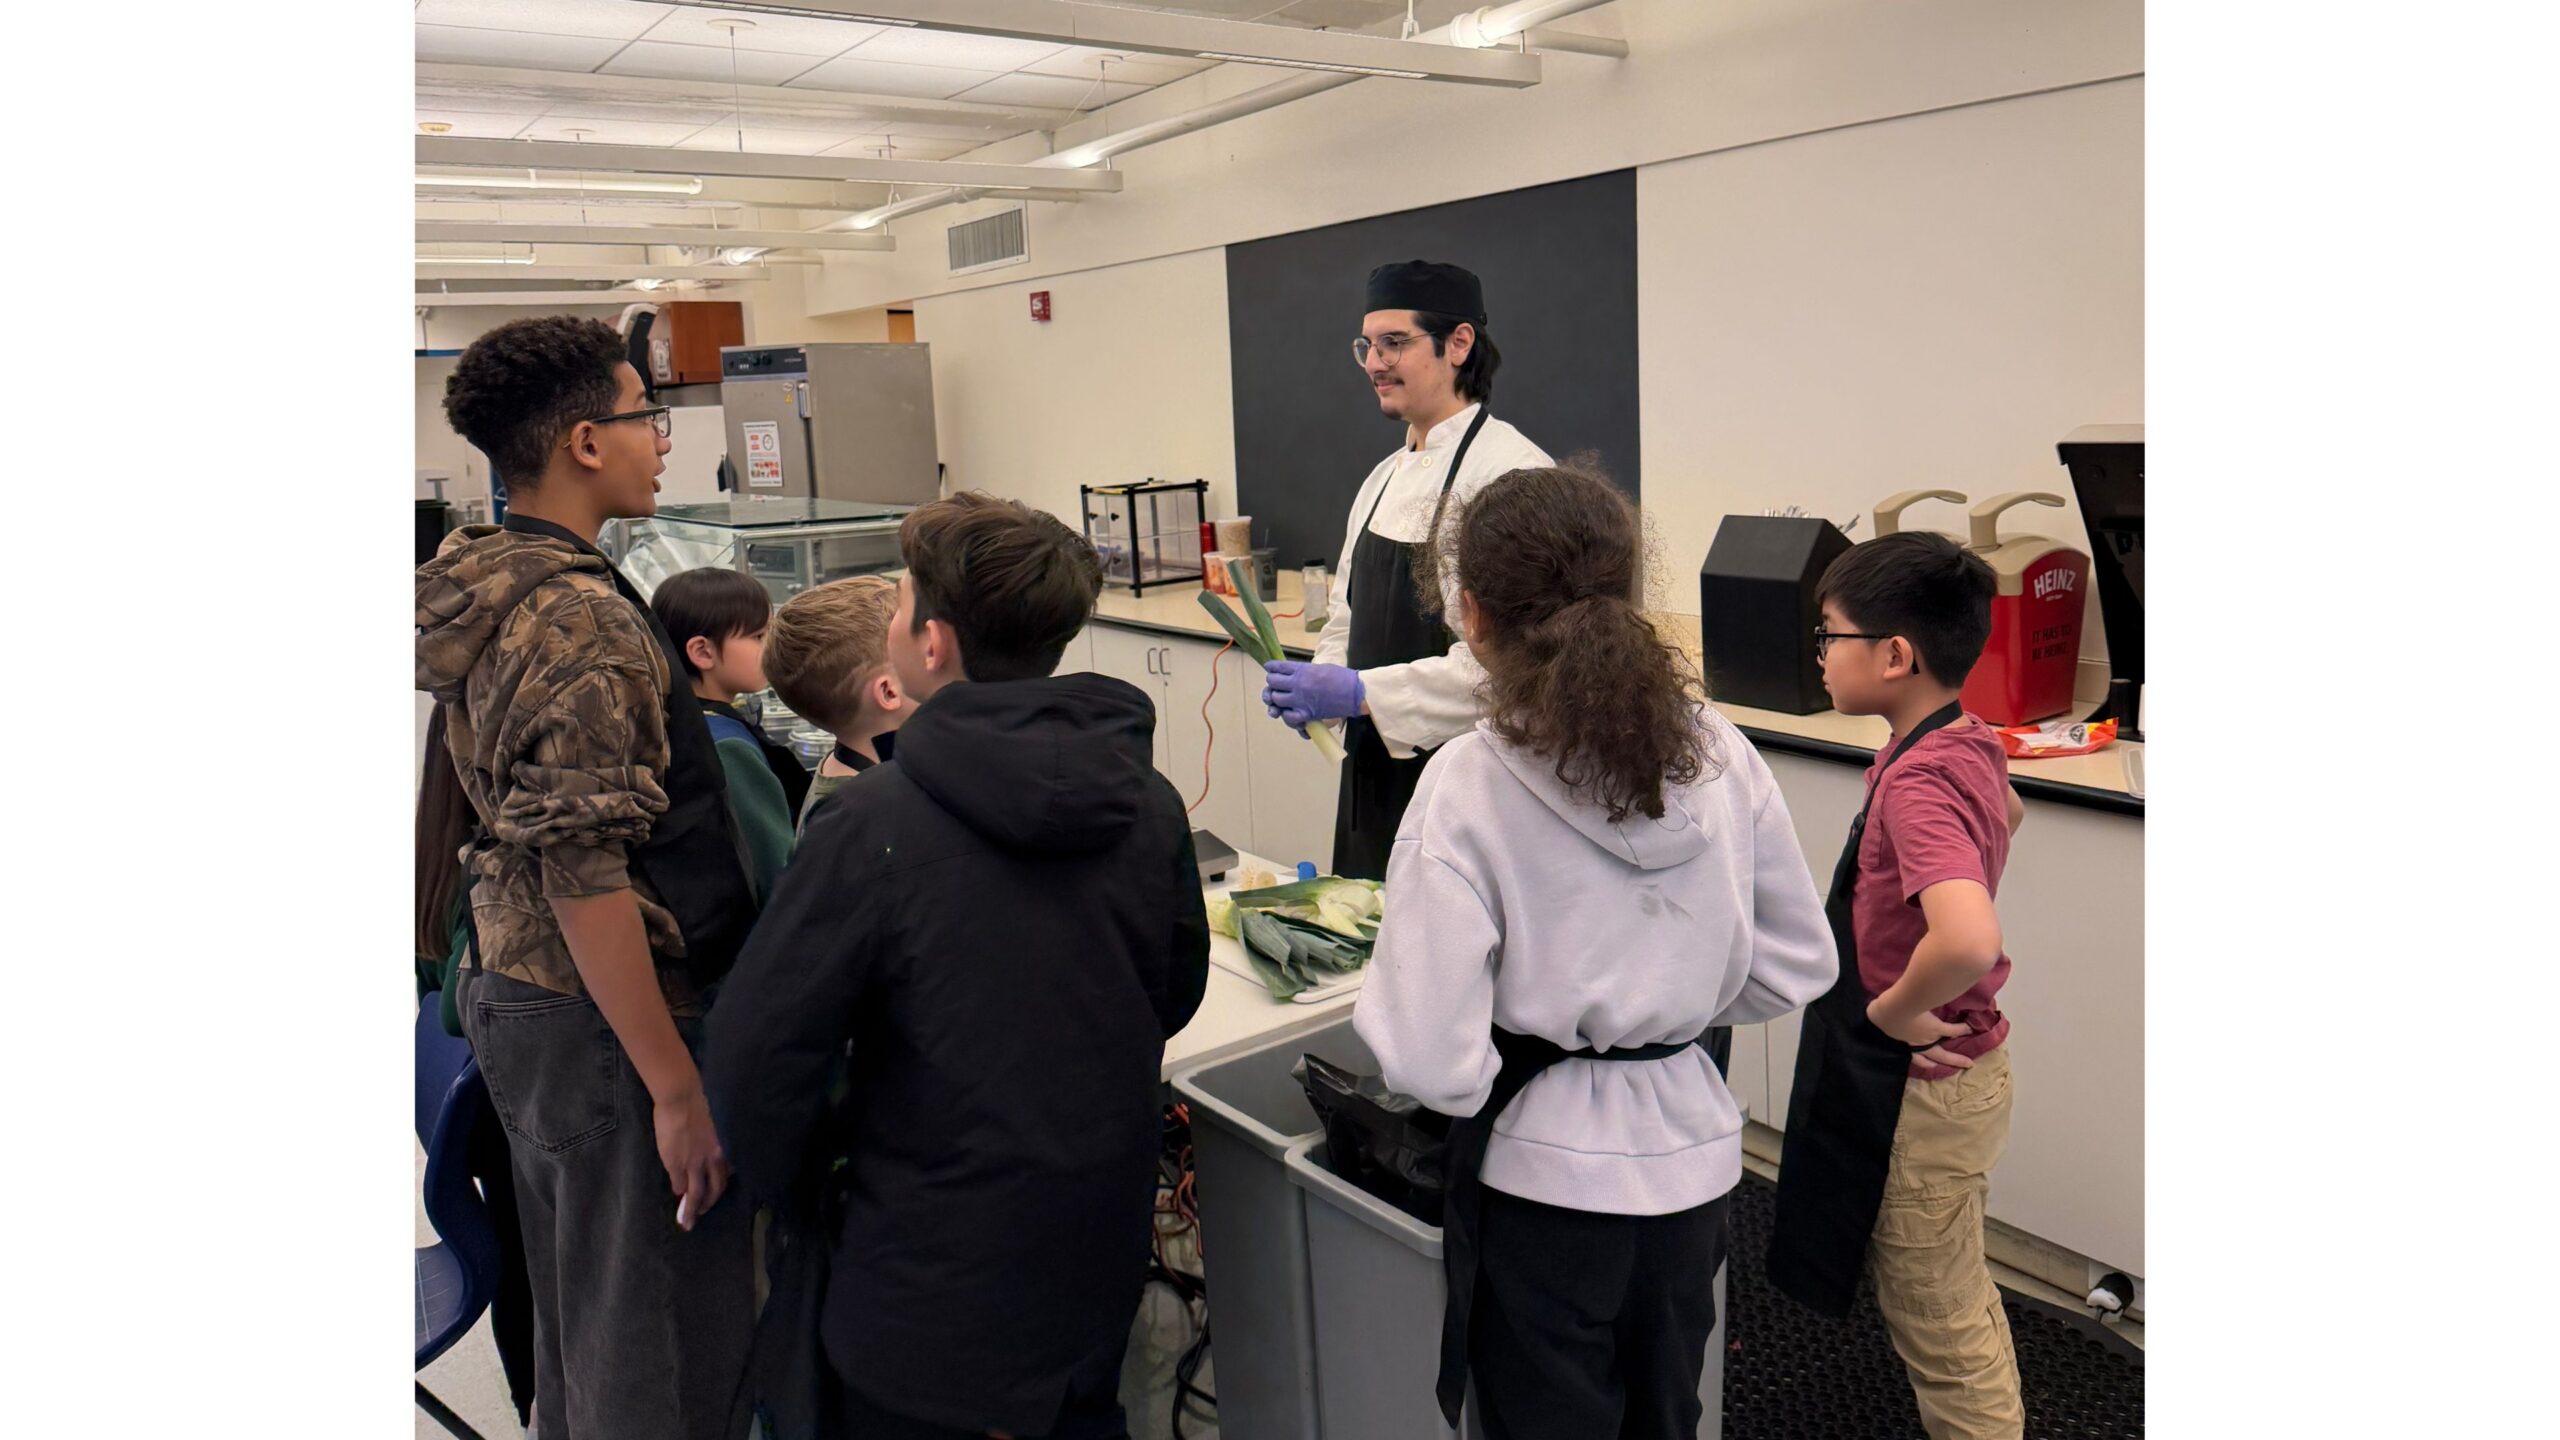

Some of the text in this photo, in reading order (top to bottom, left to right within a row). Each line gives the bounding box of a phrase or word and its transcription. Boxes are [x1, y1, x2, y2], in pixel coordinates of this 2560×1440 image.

[2034, 568, 2076, 599] HEINZ
[2032, 624, 2072, 643] IT HAS TO
